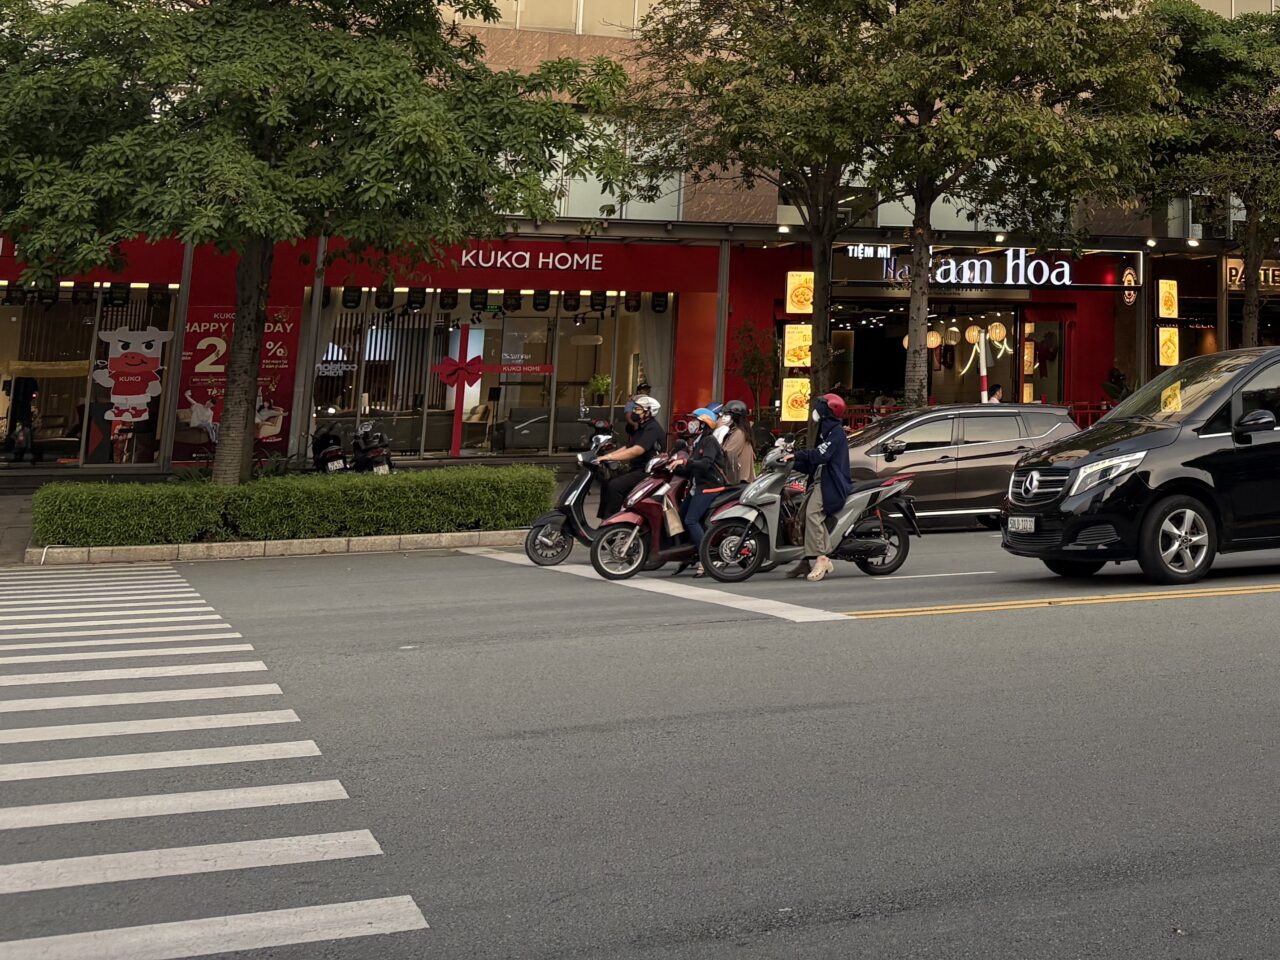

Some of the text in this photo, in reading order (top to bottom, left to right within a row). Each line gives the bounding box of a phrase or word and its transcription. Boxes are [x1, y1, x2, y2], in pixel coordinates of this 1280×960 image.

[847, 243, 874, 259] TIỆM
[538, 251, 604, 271] HOME
[1004, 247, 1073, 286] Hoa
[185, 322, 229, 333] HAPPY
